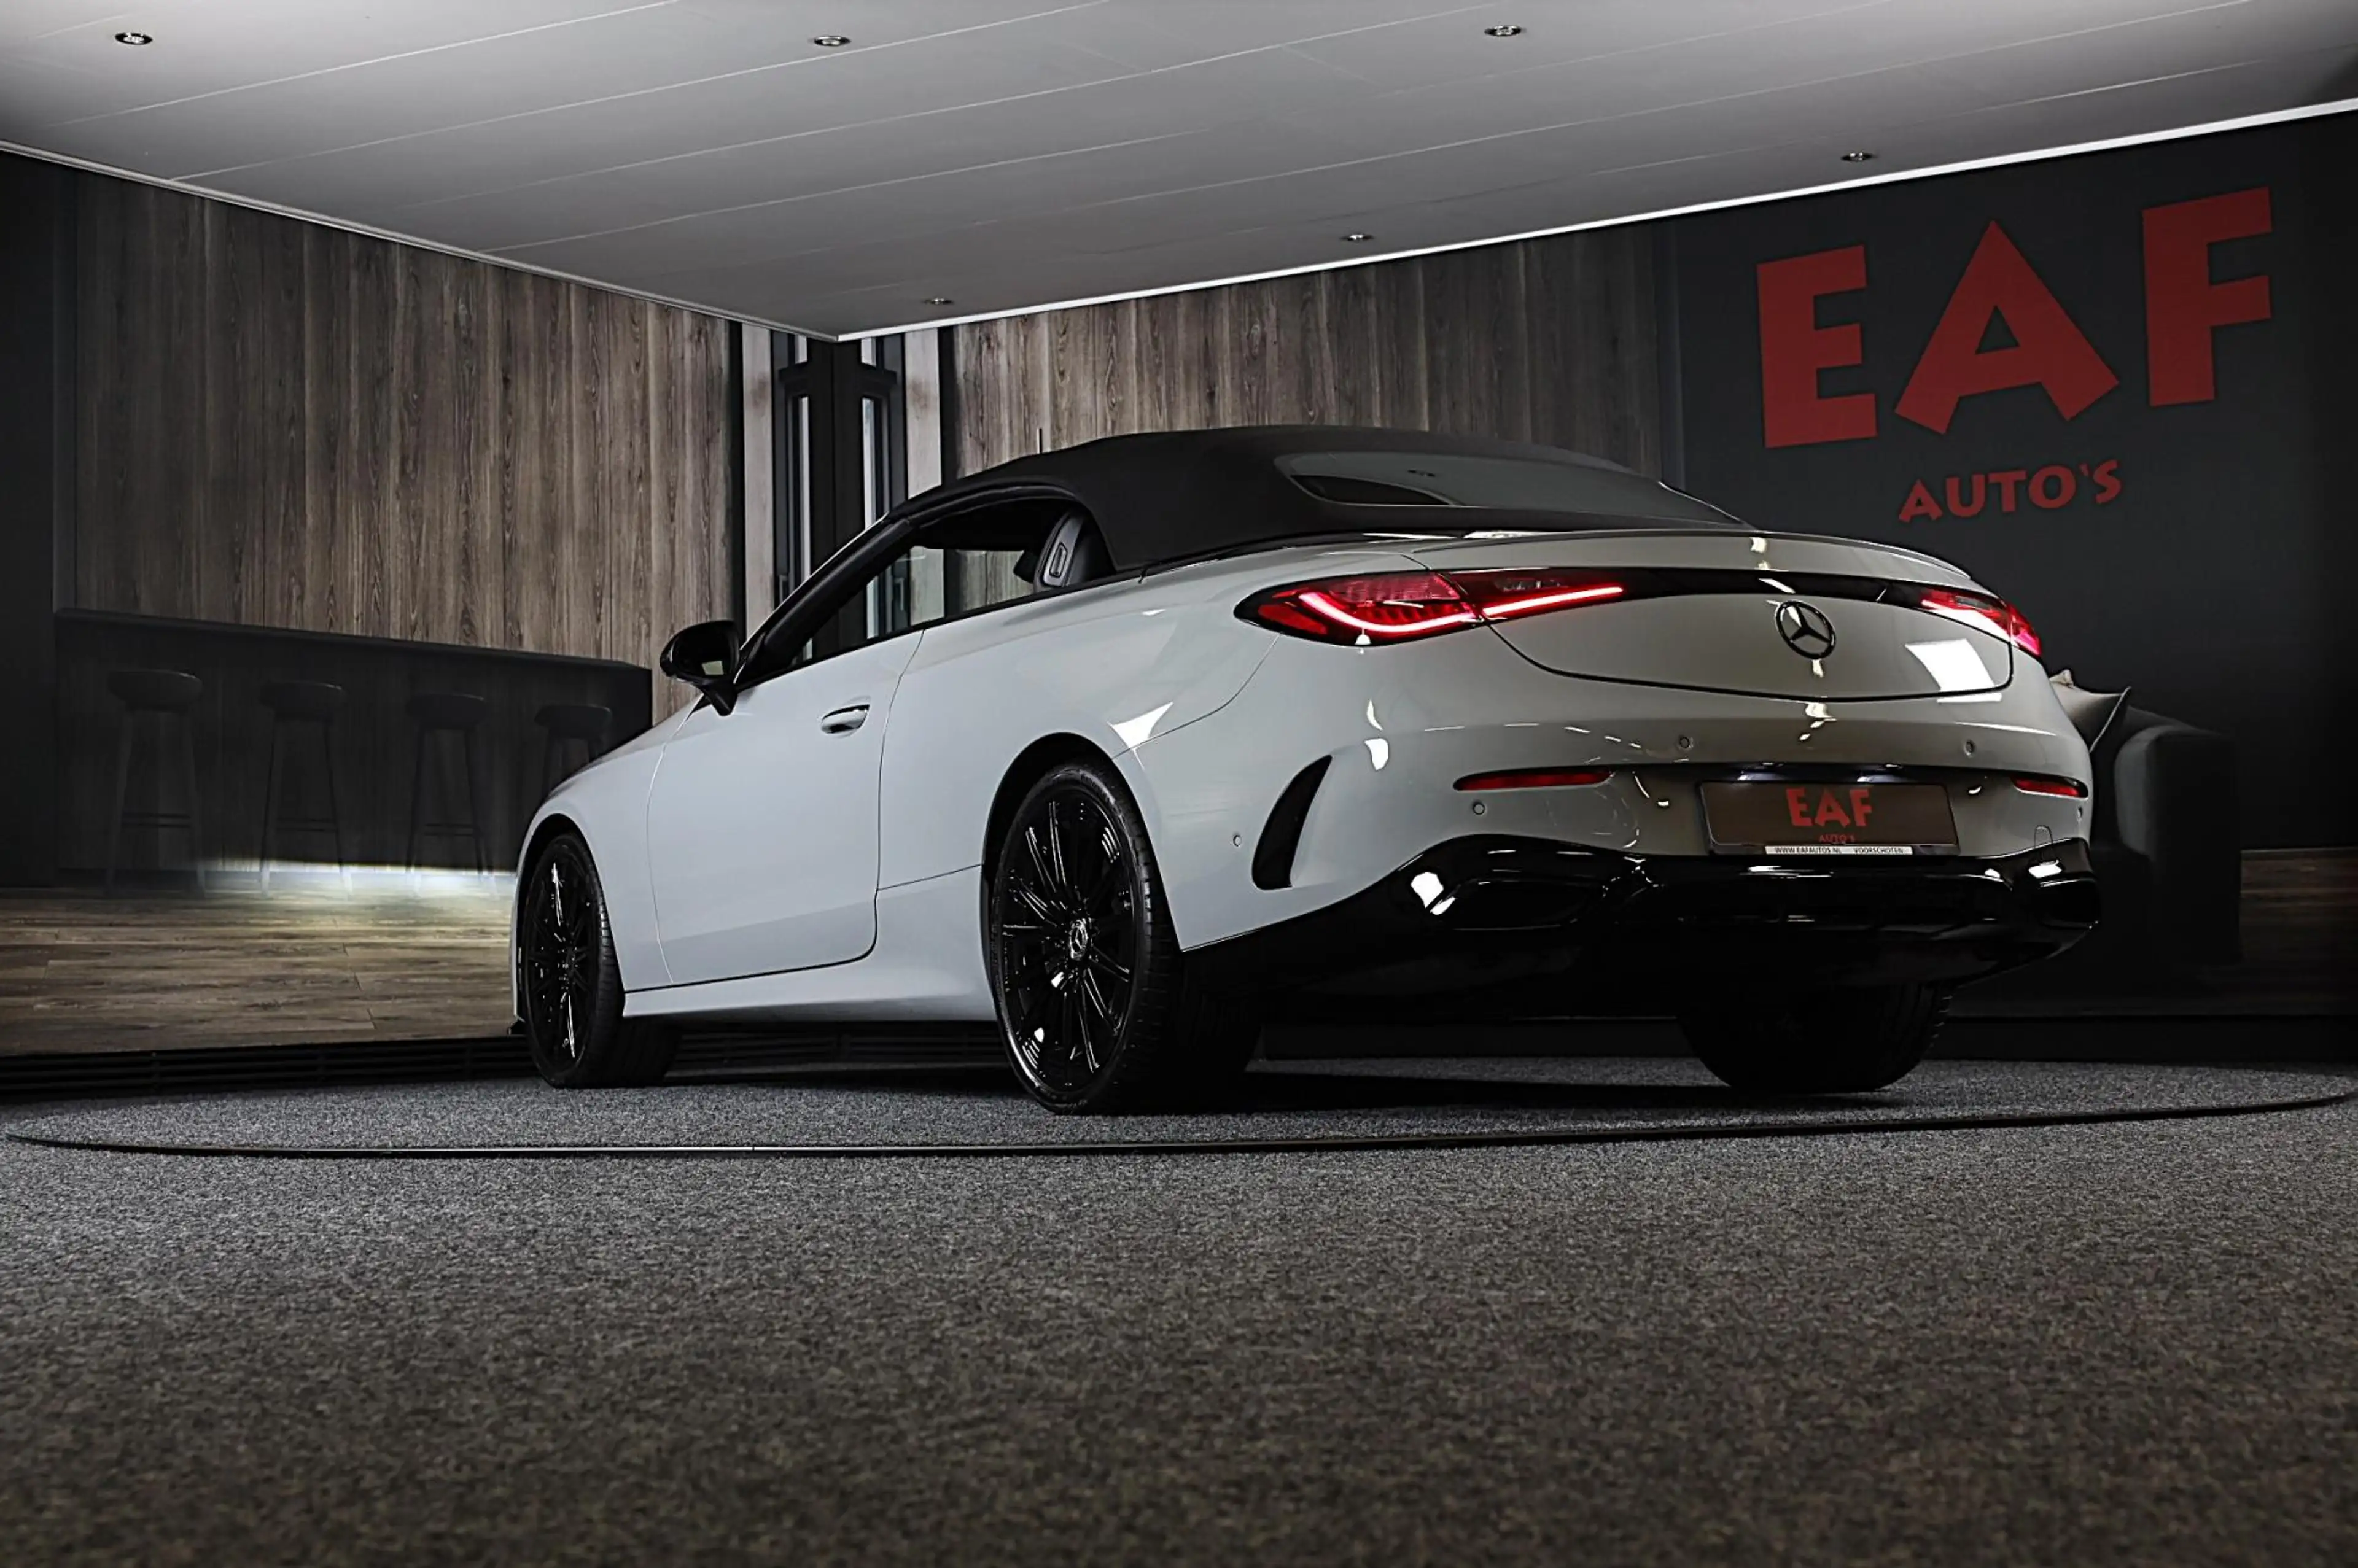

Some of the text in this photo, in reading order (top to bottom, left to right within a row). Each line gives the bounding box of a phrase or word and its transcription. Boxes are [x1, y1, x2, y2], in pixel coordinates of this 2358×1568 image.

[1756, 187, 2272, 448] EAF
[1898, 459, 2122, 523] AUTO'S
[1785, 788, 1873, 827] EAF
